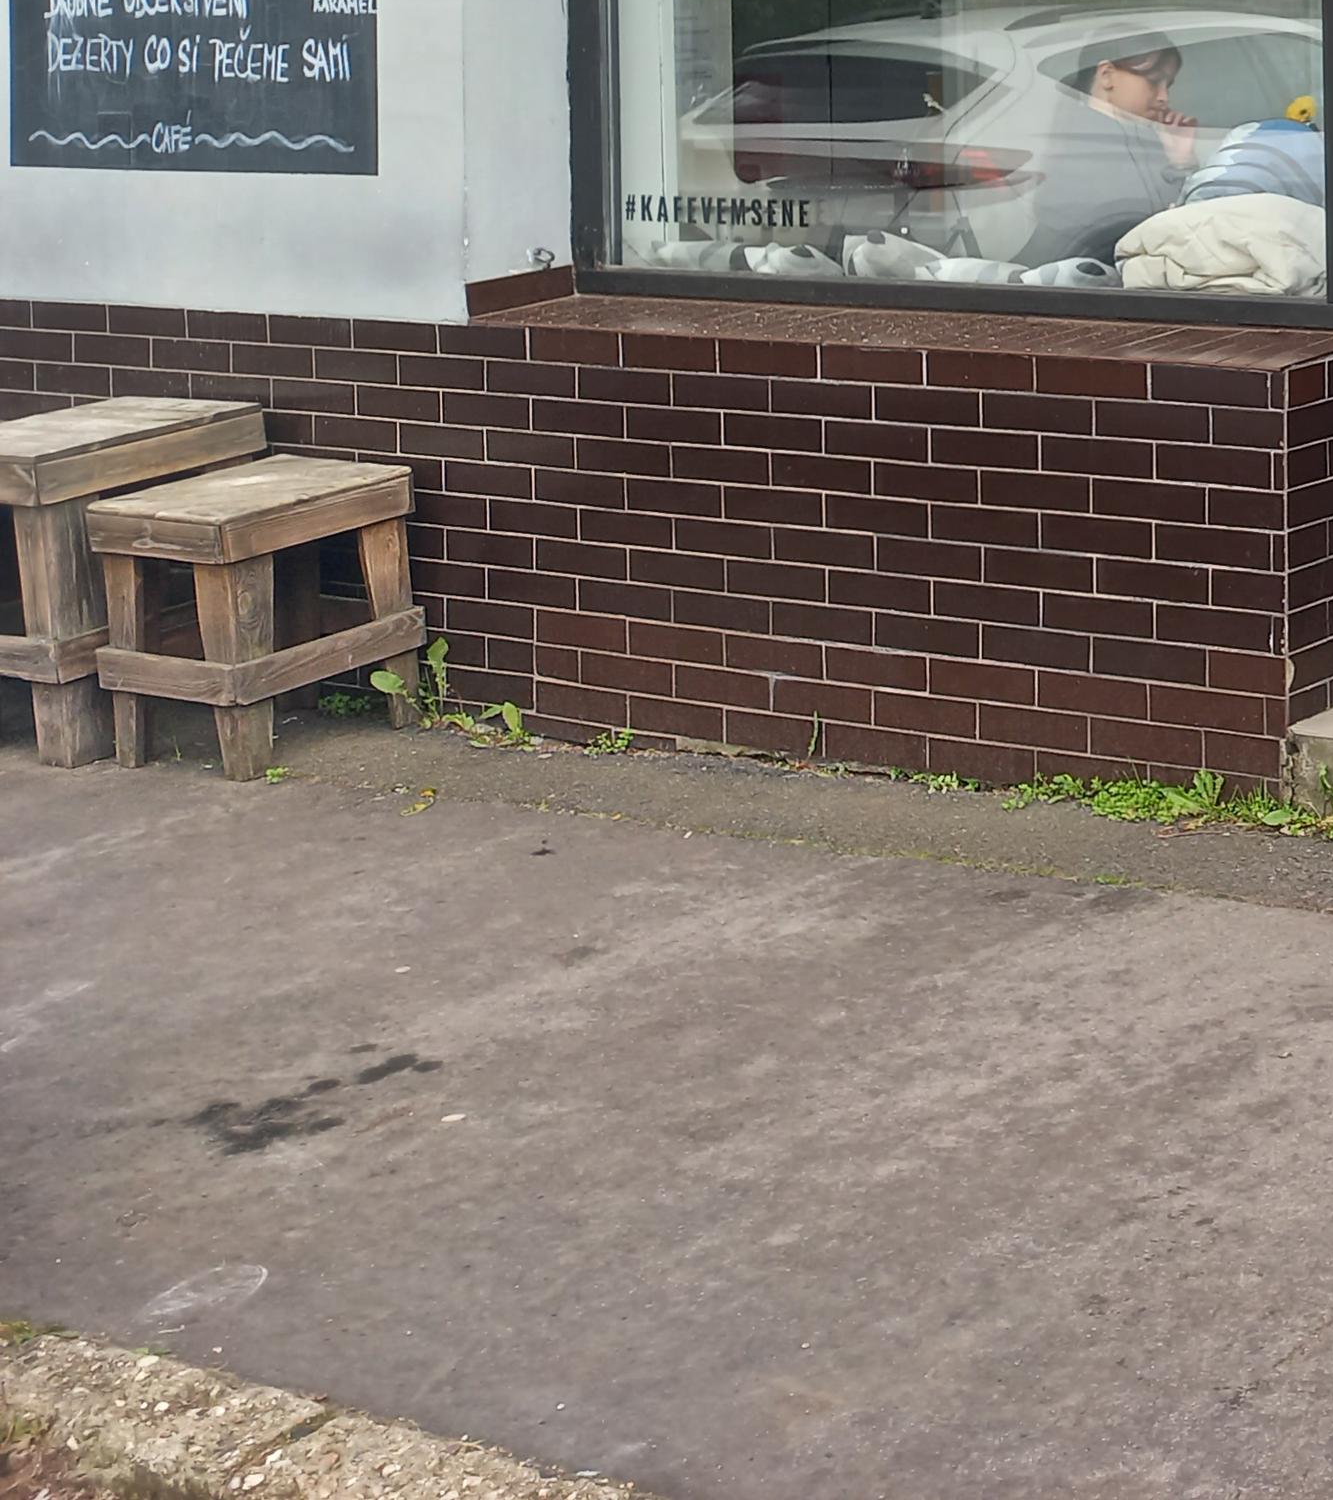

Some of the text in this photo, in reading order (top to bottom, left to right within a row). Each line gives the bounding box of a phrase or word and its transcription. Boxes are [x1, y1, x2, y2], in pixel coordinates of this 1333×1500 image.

[48, 29, 134, 79] DEZERTY
[145, 33, 171, 74] CO
[208, 24, 290, 84] PEČEME
[152, 108, 192, 154] CAFÉ
[625, 194, 811, 228] #KAFEVEMSENE
